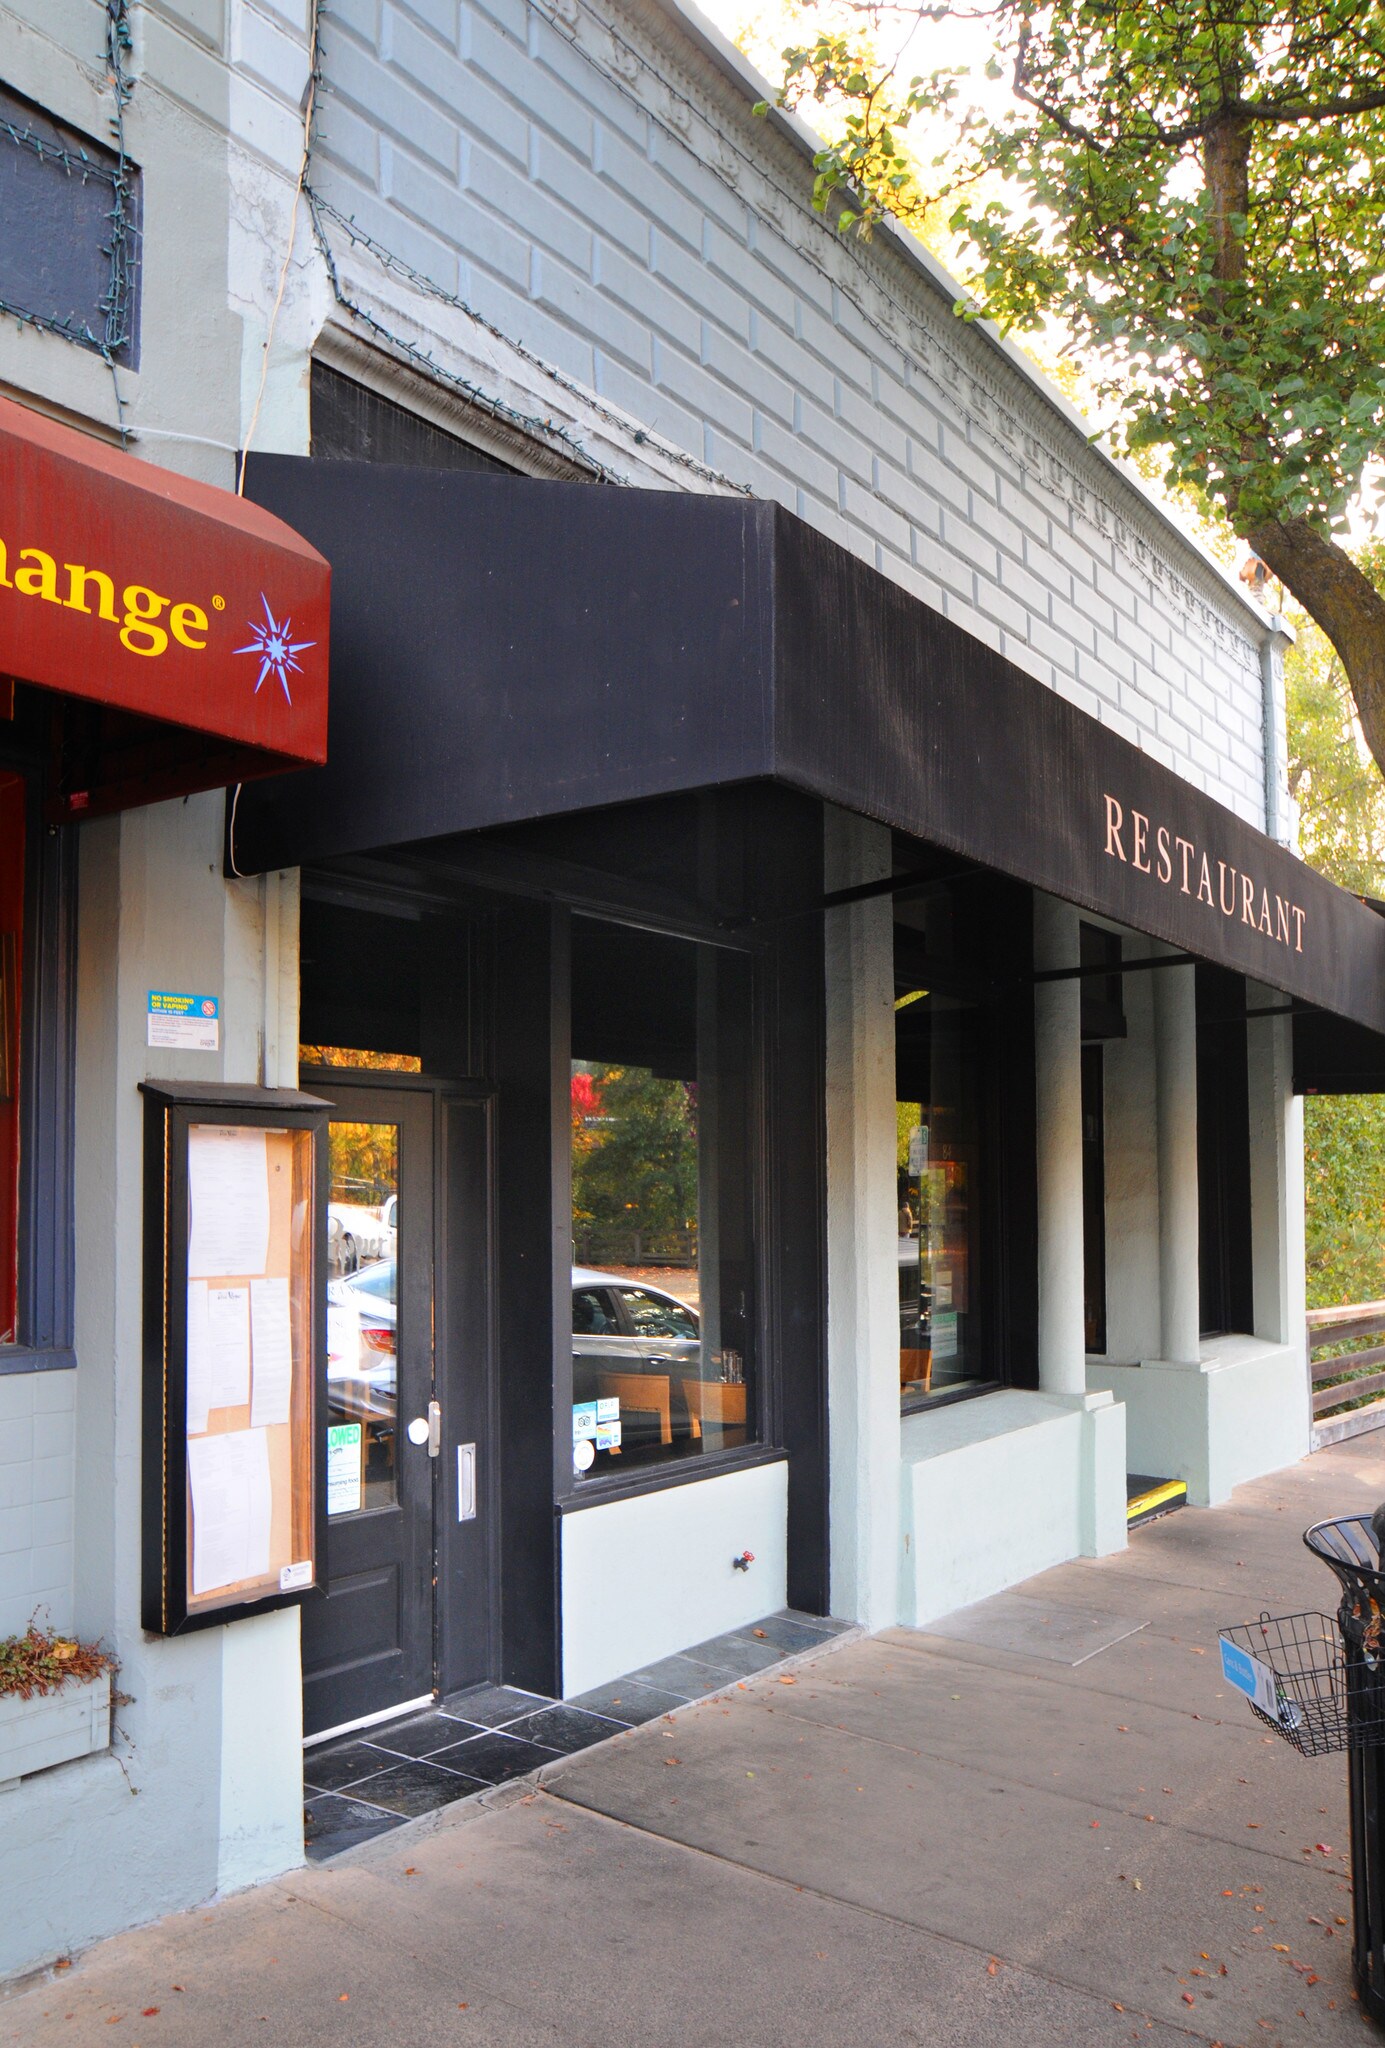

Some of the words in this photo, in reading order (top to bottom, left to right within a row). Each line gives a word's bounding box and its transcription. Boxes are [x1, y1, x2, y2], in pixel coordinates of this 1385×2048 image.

[1103, 793, 1306, 953] RESTAURANT
[164, 996, 194, 1004] SMOKING
[163, 1003, 188, 1011] VAPING
